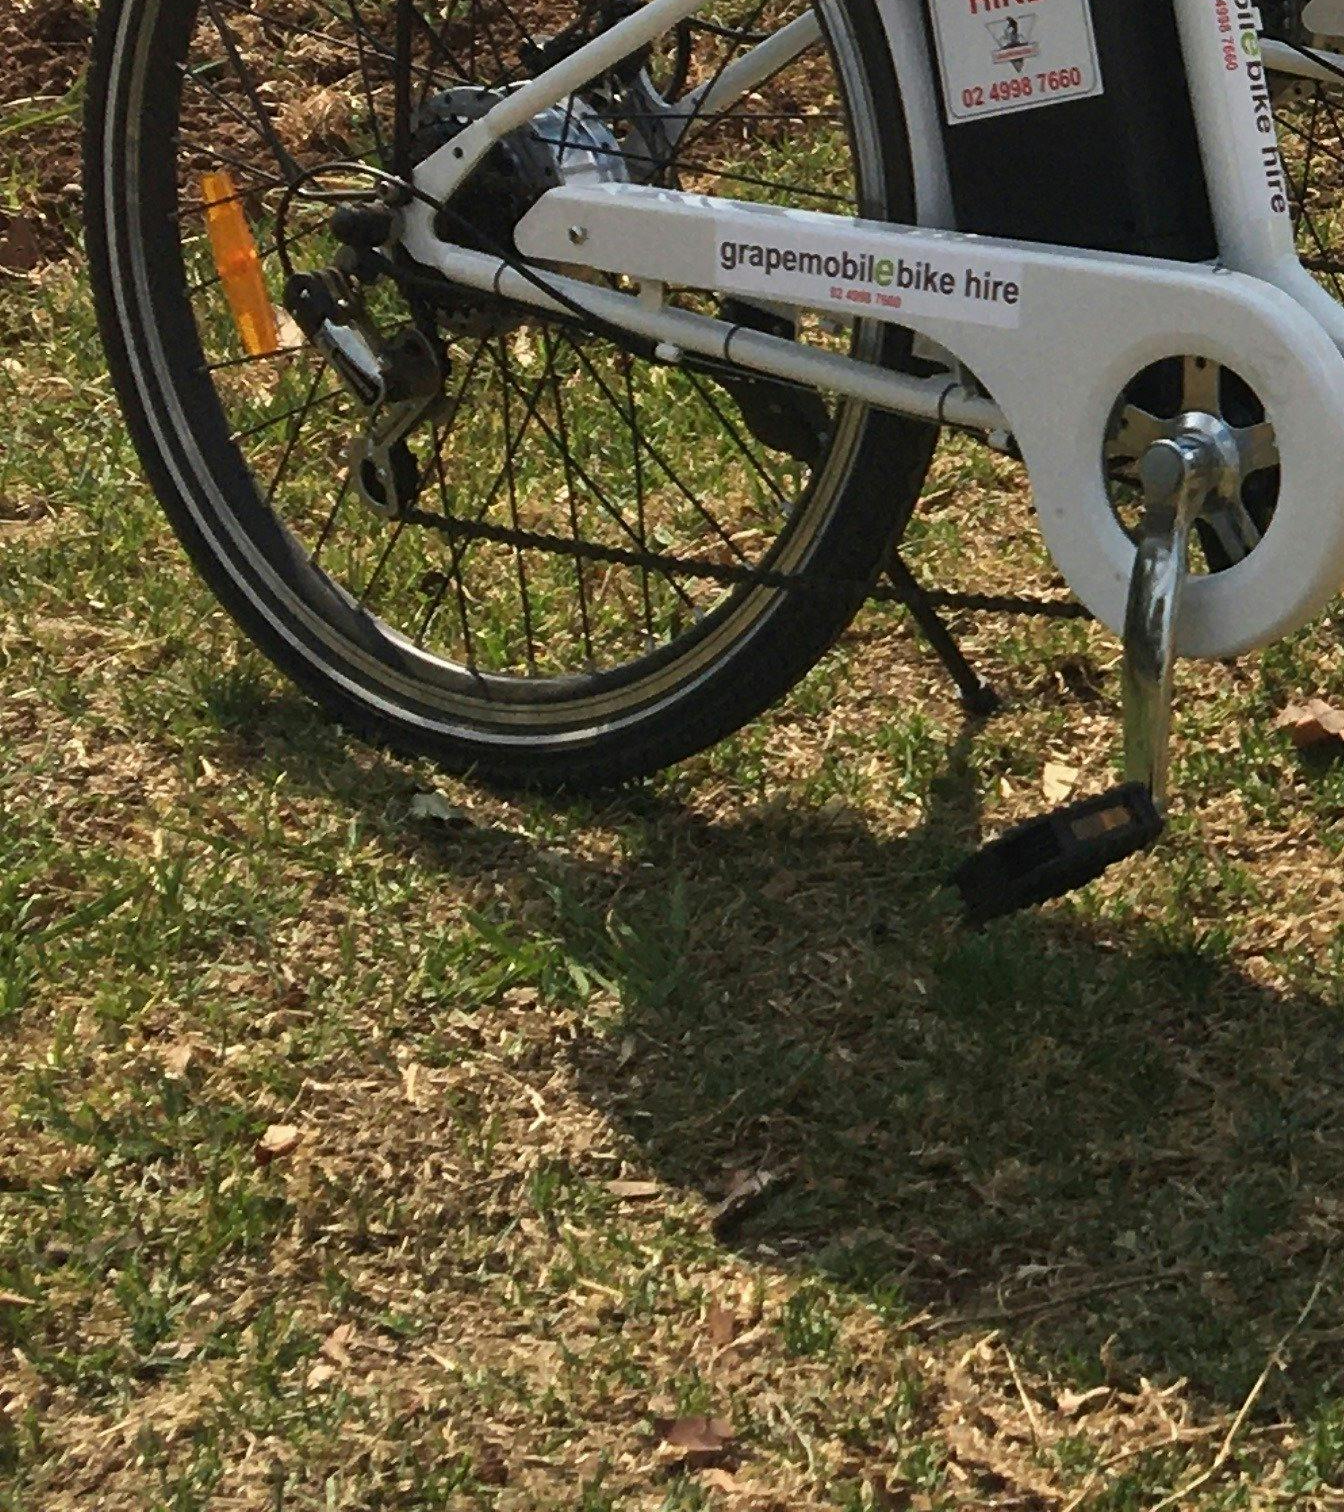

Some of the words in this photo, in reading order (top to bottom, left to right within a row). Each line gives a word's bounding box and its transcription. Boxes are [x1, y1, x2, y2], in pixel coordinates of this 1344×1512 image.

[962, 86, 985, 108] 02
[989, 76, 1033, 102] 4998
[1035, 66, 1082, 93] 7660
[720, 240, 955, 295] grapemobilebike
[964, 268, 1020, 304] hire
